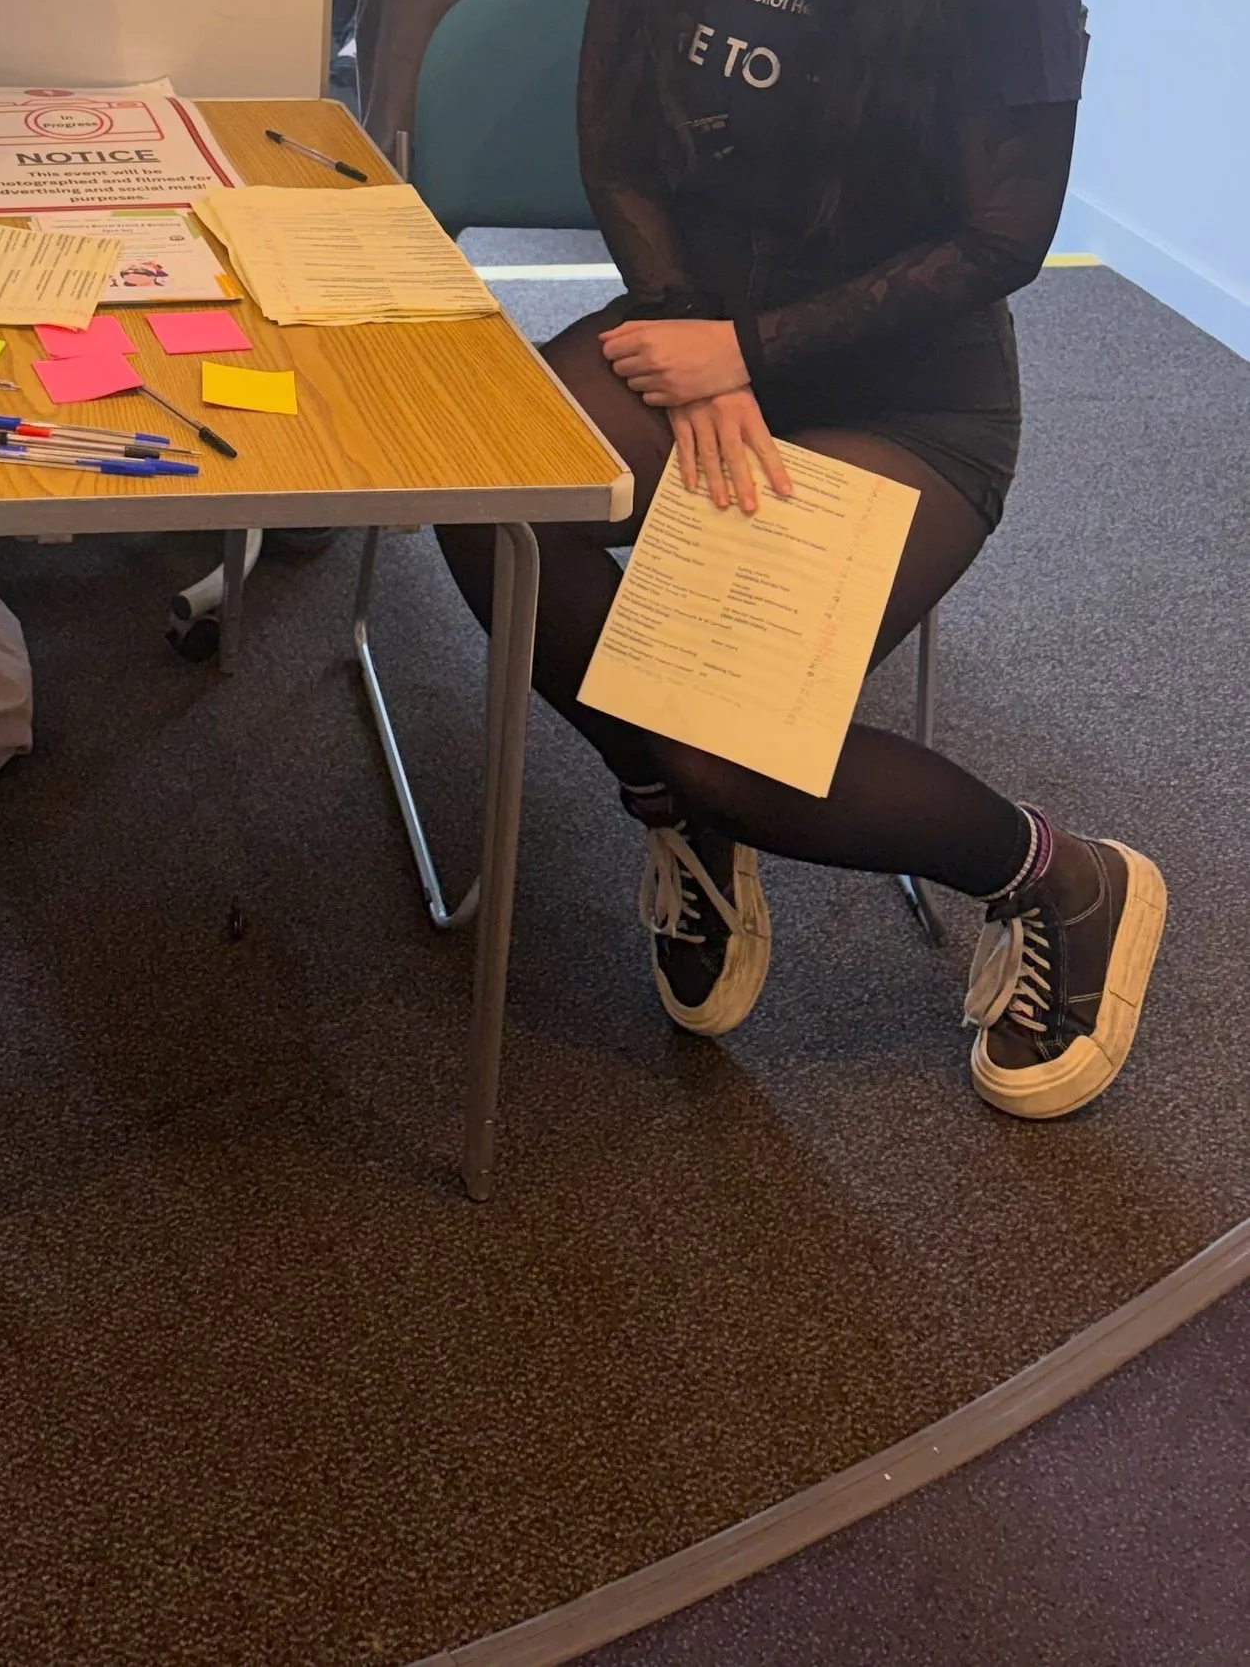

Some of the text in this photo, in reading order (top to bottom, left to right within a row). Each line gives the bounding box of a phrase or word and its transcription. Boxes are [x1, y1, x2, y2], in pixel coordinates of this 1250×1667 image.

[724, 36, 781, 89] TO
[42, 122, 98, 130] Progress
[16, 149, 160, 165] NOTICE
[26, 170, 61, 178] This
[63, 169, 108, 177] event
[110, 168, 140, 176] will
[102, 176, 132, 185] and
[135, 175, 187, 184] filmed
[84, 185, 115, 193] and
[118, 184, 165, 192] social
[168, 183, 207, 191] medi
[69, 194, 150, 204] purposes.
